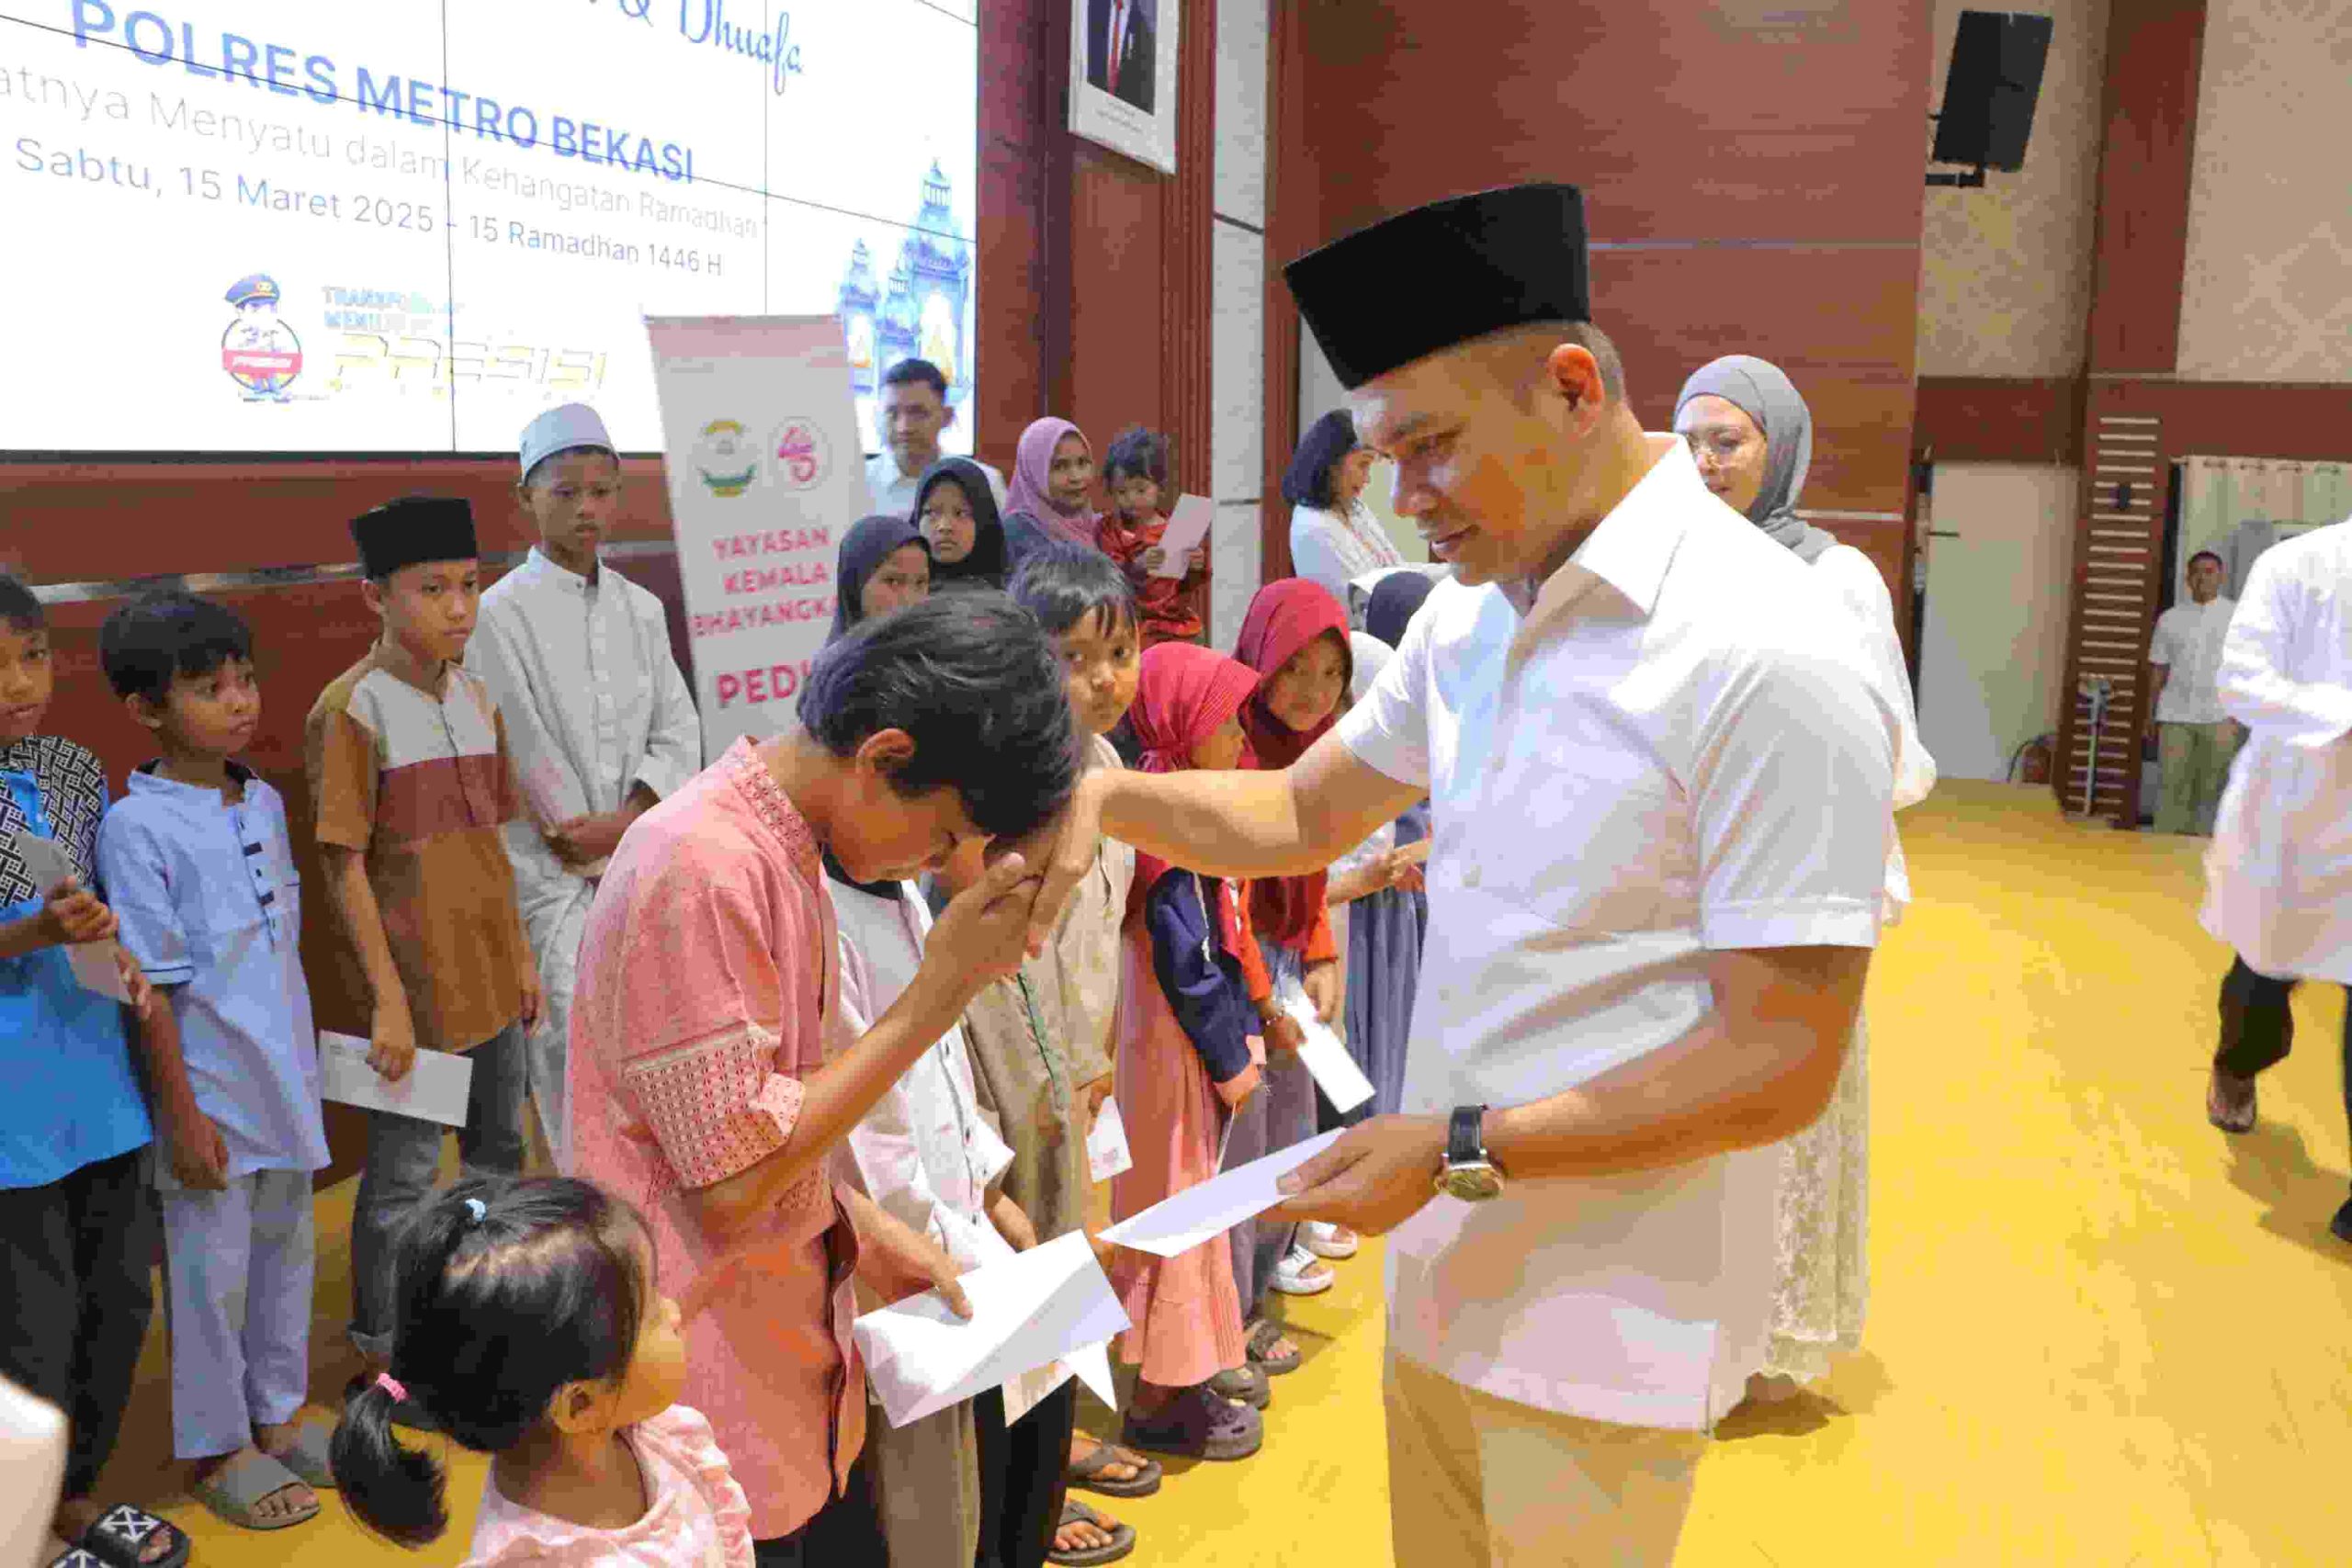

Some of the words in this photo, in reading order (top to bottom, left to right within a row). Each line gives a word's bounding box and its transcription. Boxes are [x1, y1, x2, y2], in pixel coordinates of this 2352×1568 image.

[71, 0, 339, 106] POLRES
[356, 65, 538, 150] METRO
[552, 115, 693, 184] BEKASI
[16, 137, 163, 199] Sabtu,
[179, 166, 222, 201] 15
[237, 174, 342, 220] Maret
[353, 194, 434, 233] 2025
[469, 215, 498, 243] 15
[509, 220, 639, 265] Ramadhan
[648, 243, 701, 275] 1446
[707, 254, 722, 276] H
[151, 91, 331, 158] Menyatu
[345, 134, 448, 180] dalam
[462, 156, 631, 213] Kehangatan
[639, 190, 758, 239] Ramadhan
[713, 527, 831, 562] YAYASAN
[723, 561, 831, 594] KEMALA
